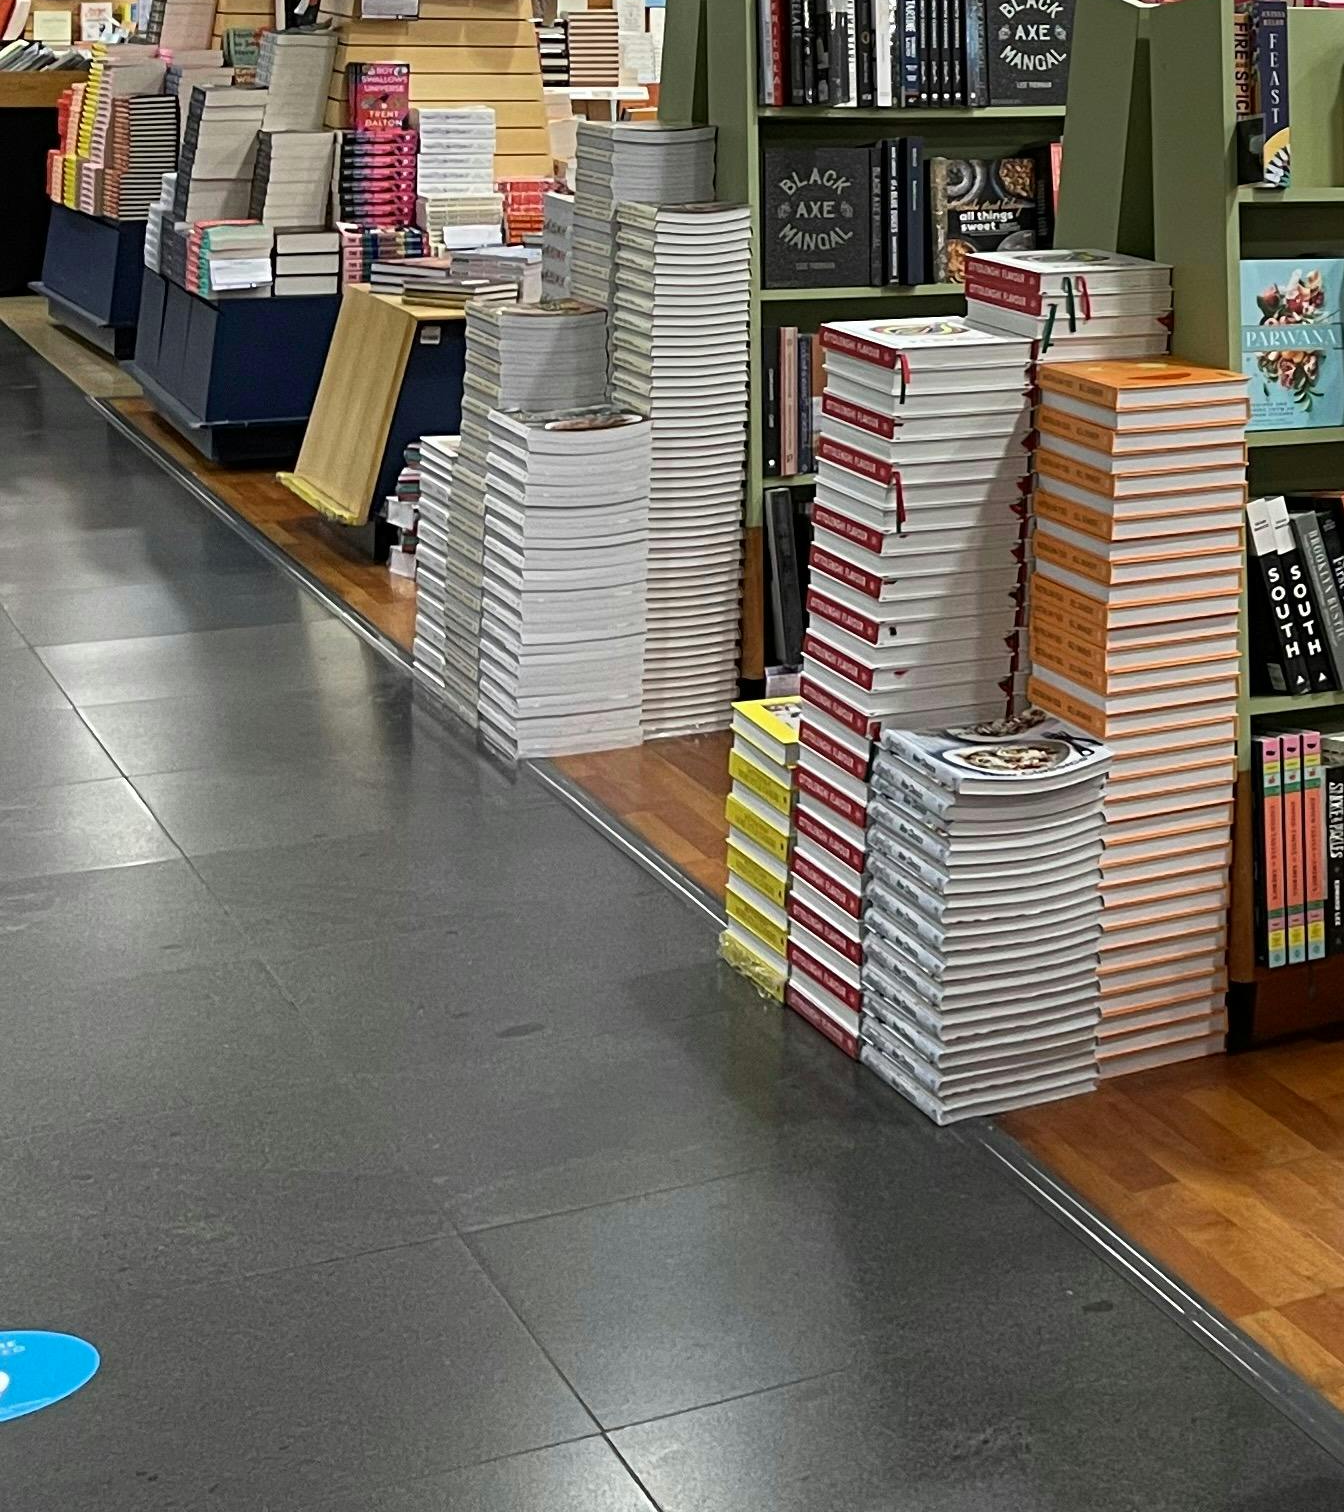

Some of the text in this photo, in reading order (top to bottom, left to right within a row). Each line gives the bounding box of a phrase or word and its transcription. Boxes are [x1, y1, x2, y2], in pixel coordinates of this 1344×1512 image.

[1015, 24, 1051, 41] AXE
[1269, 34, 1279, 124] FEAST
[369, 110, 399, 118] TRENT
[365, 118, 403, 128] DALTON
[779, 168, 851, 196] BLACK
[796, 201, 835, 218] AXE
[959, 210, 1014, 222] all things
[960, 222, 996, 232] sweet
[1246, 328, 1340, 349] PARWANA
[1267, 567, 1300, 658] SOUTH
[1290, 564, 1322, 656] SOUTH
